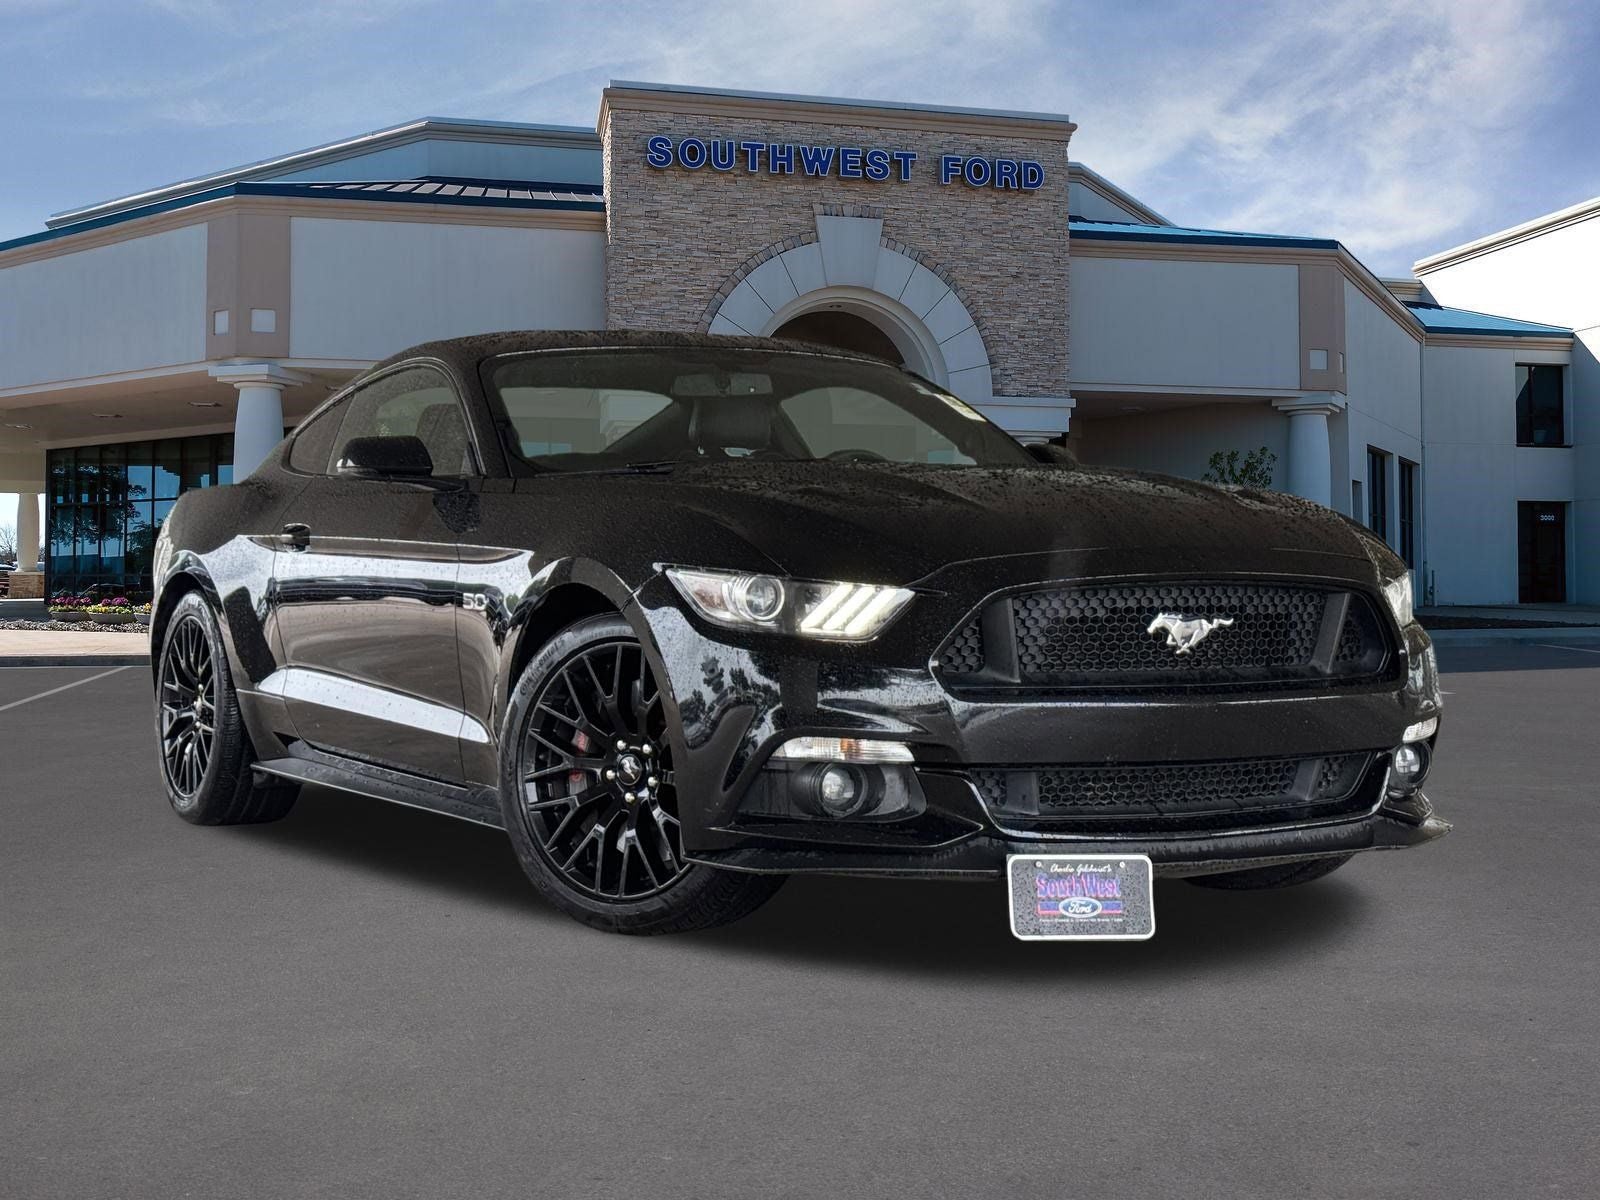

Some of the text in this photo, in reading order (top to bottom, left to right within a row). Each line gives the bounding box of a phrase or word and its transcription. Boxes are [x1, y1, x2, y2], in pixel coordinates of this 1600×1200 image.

[646, 135, 1046, 190] SOUTHWEST FORD
[1068, 901, 1093, 913] Ford
